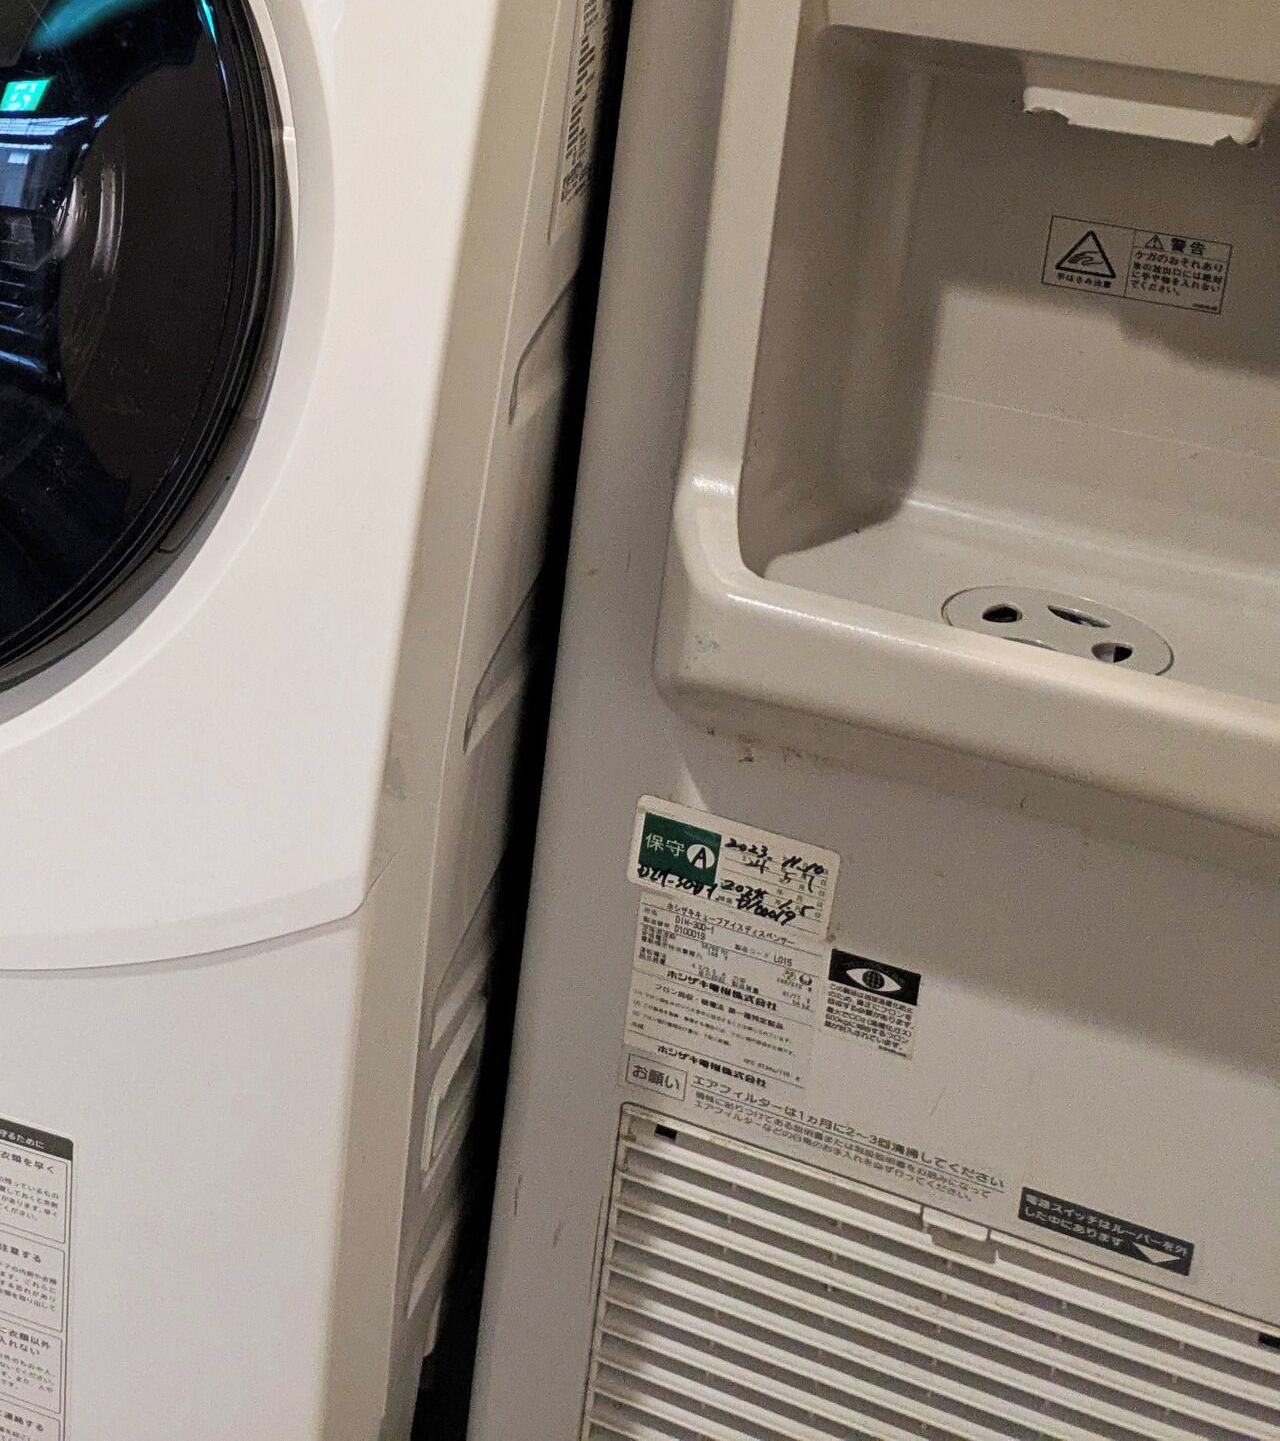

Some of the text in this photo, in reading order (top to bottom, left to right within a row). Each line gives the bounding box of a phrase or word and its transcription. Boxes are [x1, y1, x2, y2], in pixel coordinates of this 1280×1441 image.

[1170, 237, 1206, 256] 警告
[1134, 250, 1224, 273] ケガのおそれあり
[644, 832, 707, 870] 保守 A
[632, 1064, 680, 1090] お願い
